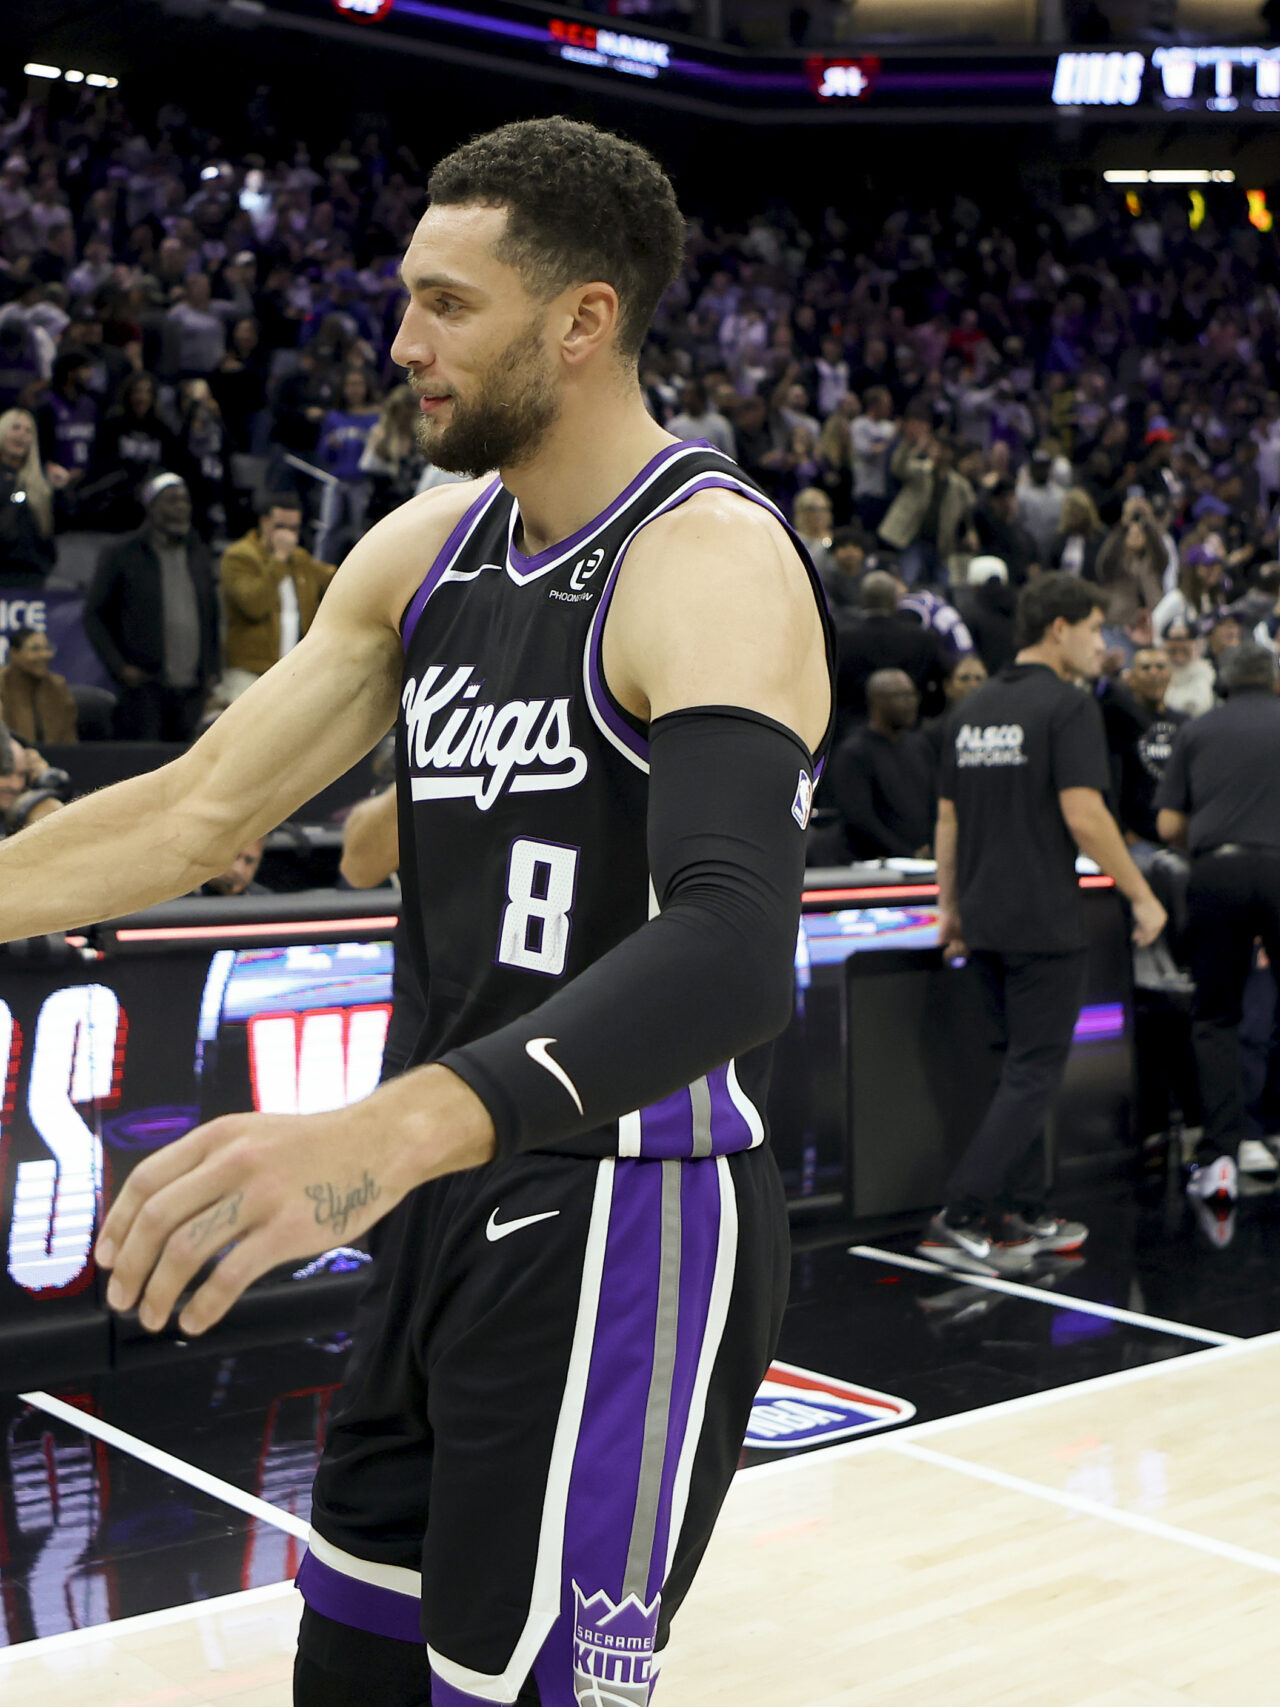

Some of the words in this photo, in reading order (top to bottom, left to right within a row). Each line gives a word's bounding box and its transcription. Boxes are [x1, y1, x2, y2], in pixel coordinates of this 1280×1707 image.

[402, 663, 588, 811] Kings
[496, 836, 580, 978] 8
[577, 1625, 655, 1650] SACRAME
